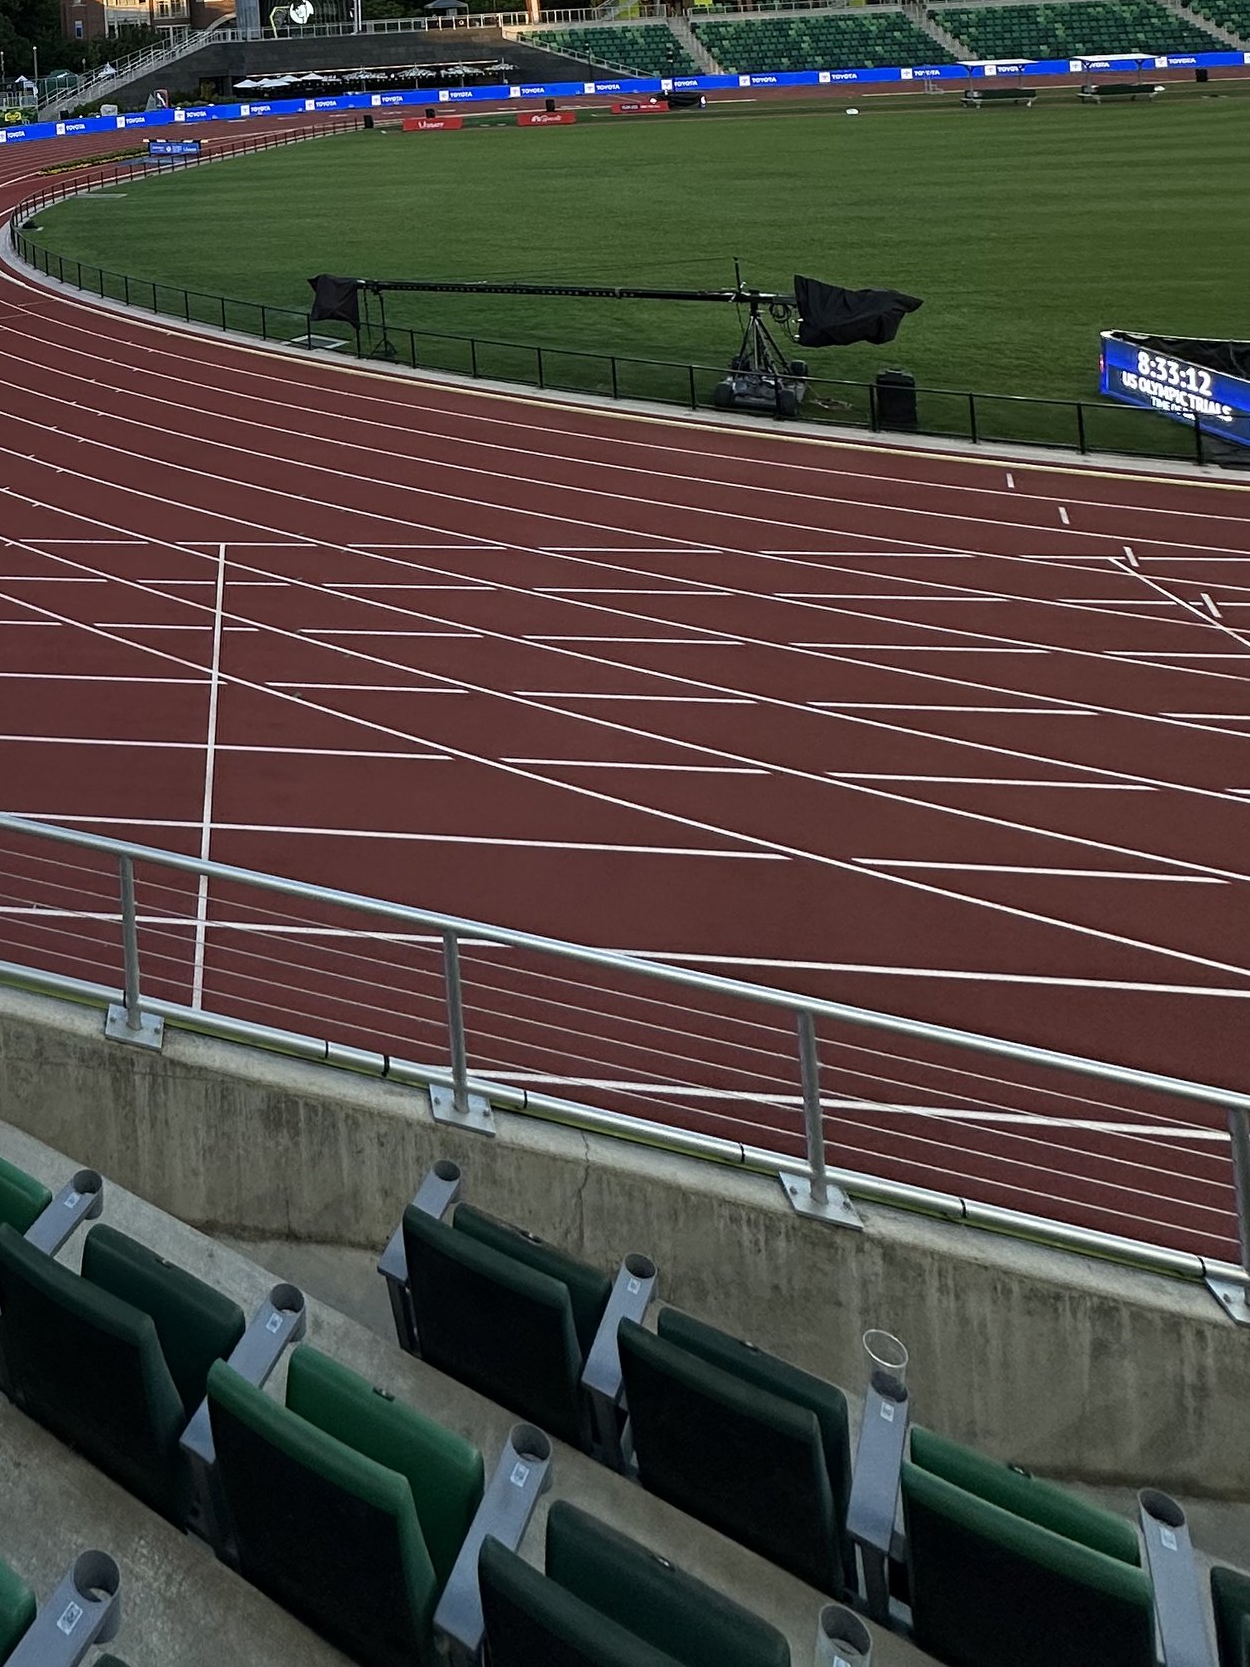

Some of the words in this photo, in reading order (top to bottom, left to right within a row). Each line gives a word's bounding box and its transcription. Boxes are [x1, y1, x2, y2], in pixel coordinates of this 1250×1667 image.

[751, 75, 777, 84] TOYOTA
[831, 72, 858, 81] TOYOTA
[596, 83, 621, 92] TOYOTA
[1137, 351, 1213, 396] 8:33:12
[1122, 370, 1138, 390] US
[1138, 377, 1188, 406] OLYMPIC
[1187, 393, 1233, 422] TRIALS
